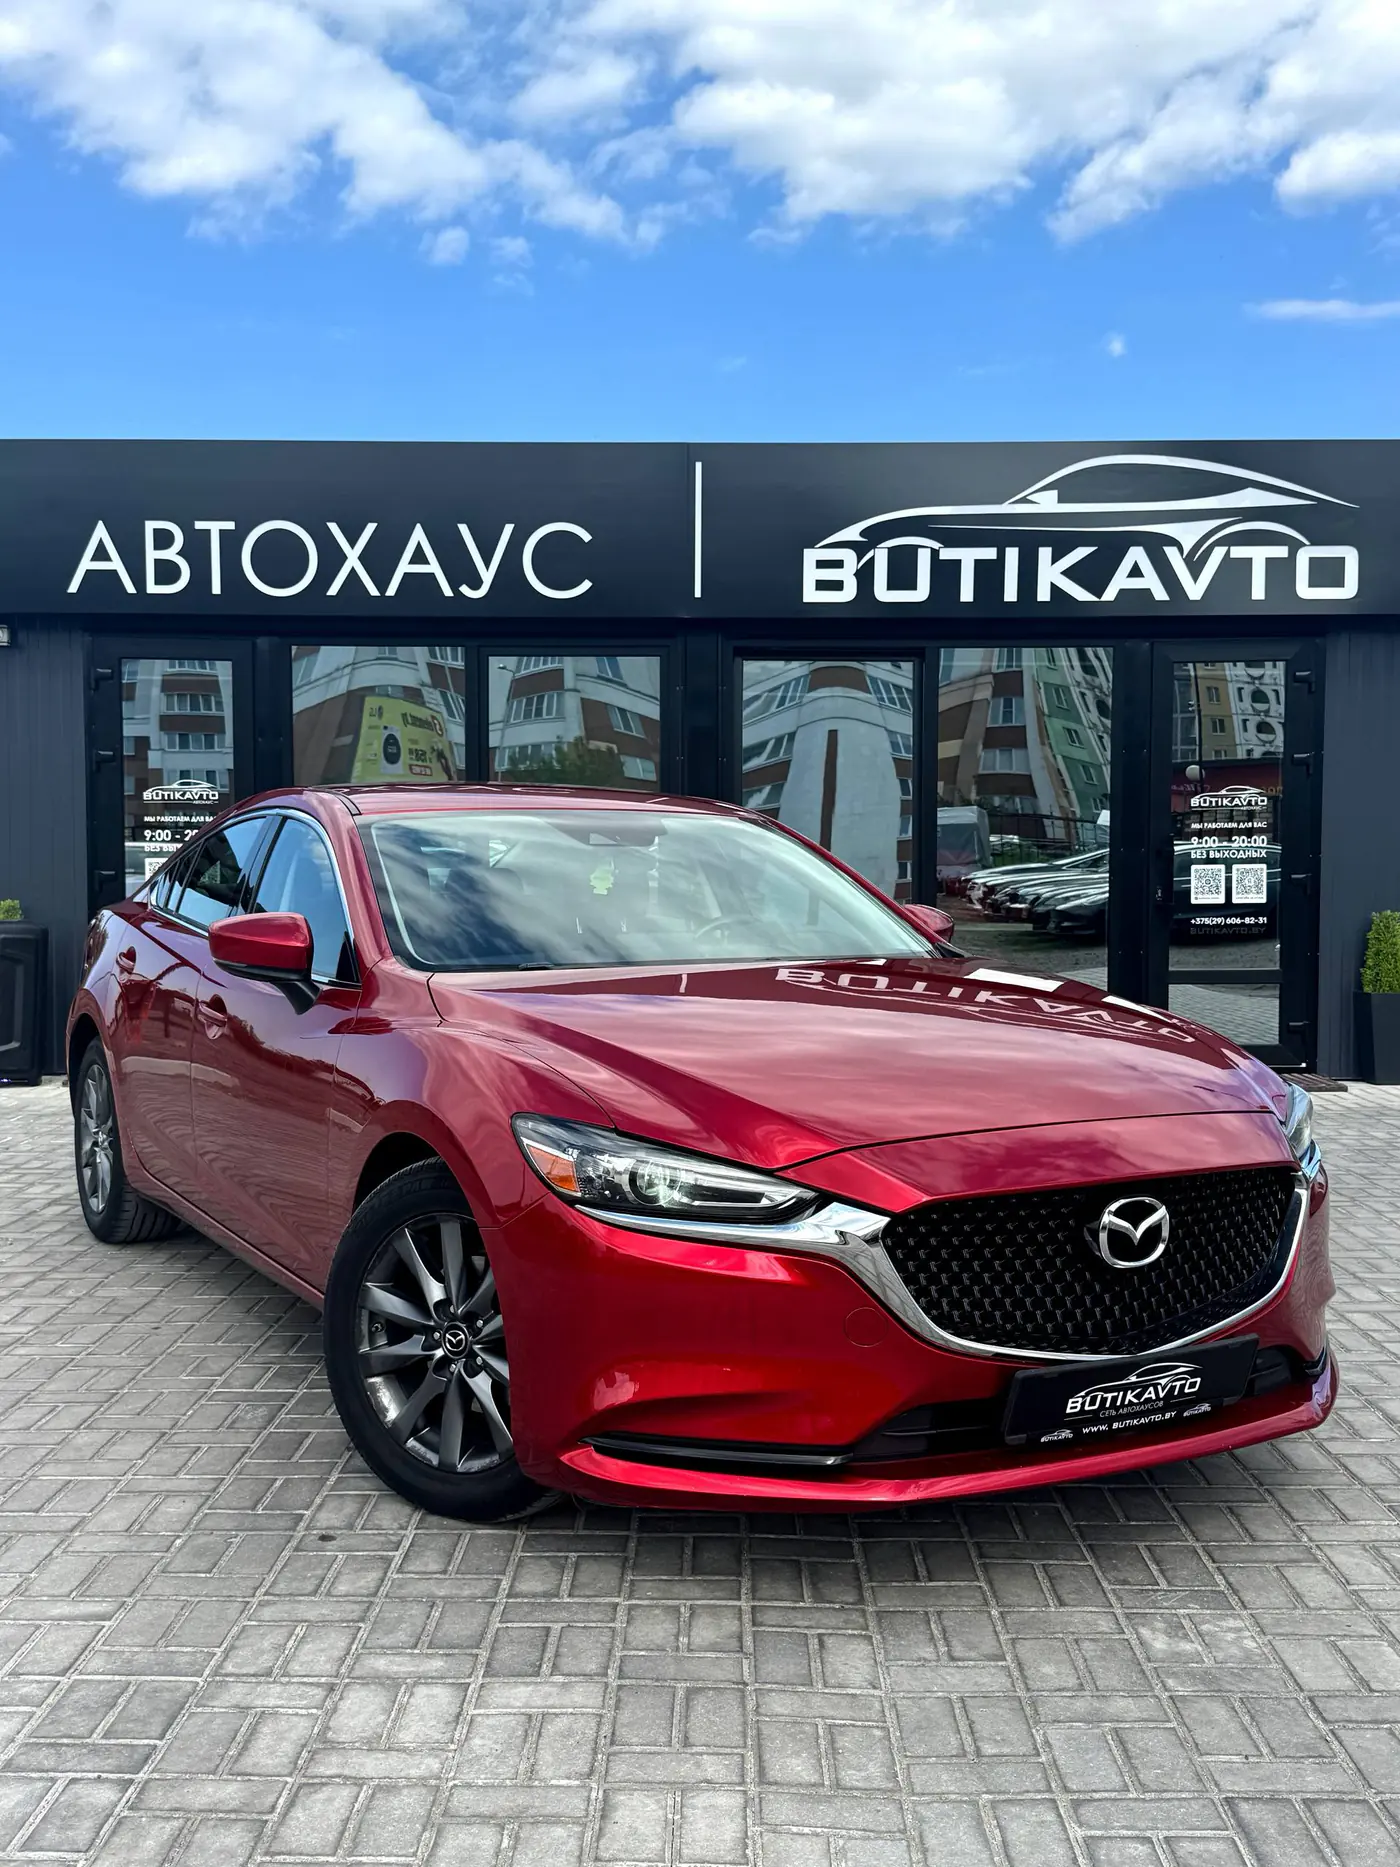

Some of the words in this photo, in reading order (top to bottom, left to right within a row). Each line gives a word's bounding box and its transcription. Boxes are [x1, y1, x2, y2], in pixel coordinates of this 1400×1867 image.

[66, 520, 594, 600] АВТОХАУС
[802, 545, 1360, 604] BUTIKAVTO
[143, 792, 219, 800] BUTIKAVTO
[1190, 797, 1267, 807] BUTIKAVTO
[144, 829, 172, 841] 9:00
[1191, 836, 1219, 848] 9:00
[1232, 835, 1268, 848] 20:00
[1191, 850, 1207, 859] БЕЗ
[1209, 850, 1267, 859] ВЫХОДНЫХ
[1190, 917, 1225, 926] +375(29)
[1226, 917, 1267, 925] 606-82-31
[1190, 927, 1266, 935] BUTIKAVTO.BY
[1065, 1377, 1201, 1414] BUTIKAVTO
[1099, 1407, 1117, 1417] СЕТЬ
[1117, 1400, 1164, 1416] АВТОХАУСОВ
[1183, 1407, 1211, 1416] BUTIKAVTO
[1082, 1425, 1109, 1434] WWW.
[1111, 1410, 1176, 1429] BUTIKAVTO.BY
[1040, 1434, 1073, 1442] BUTIKAVTO
